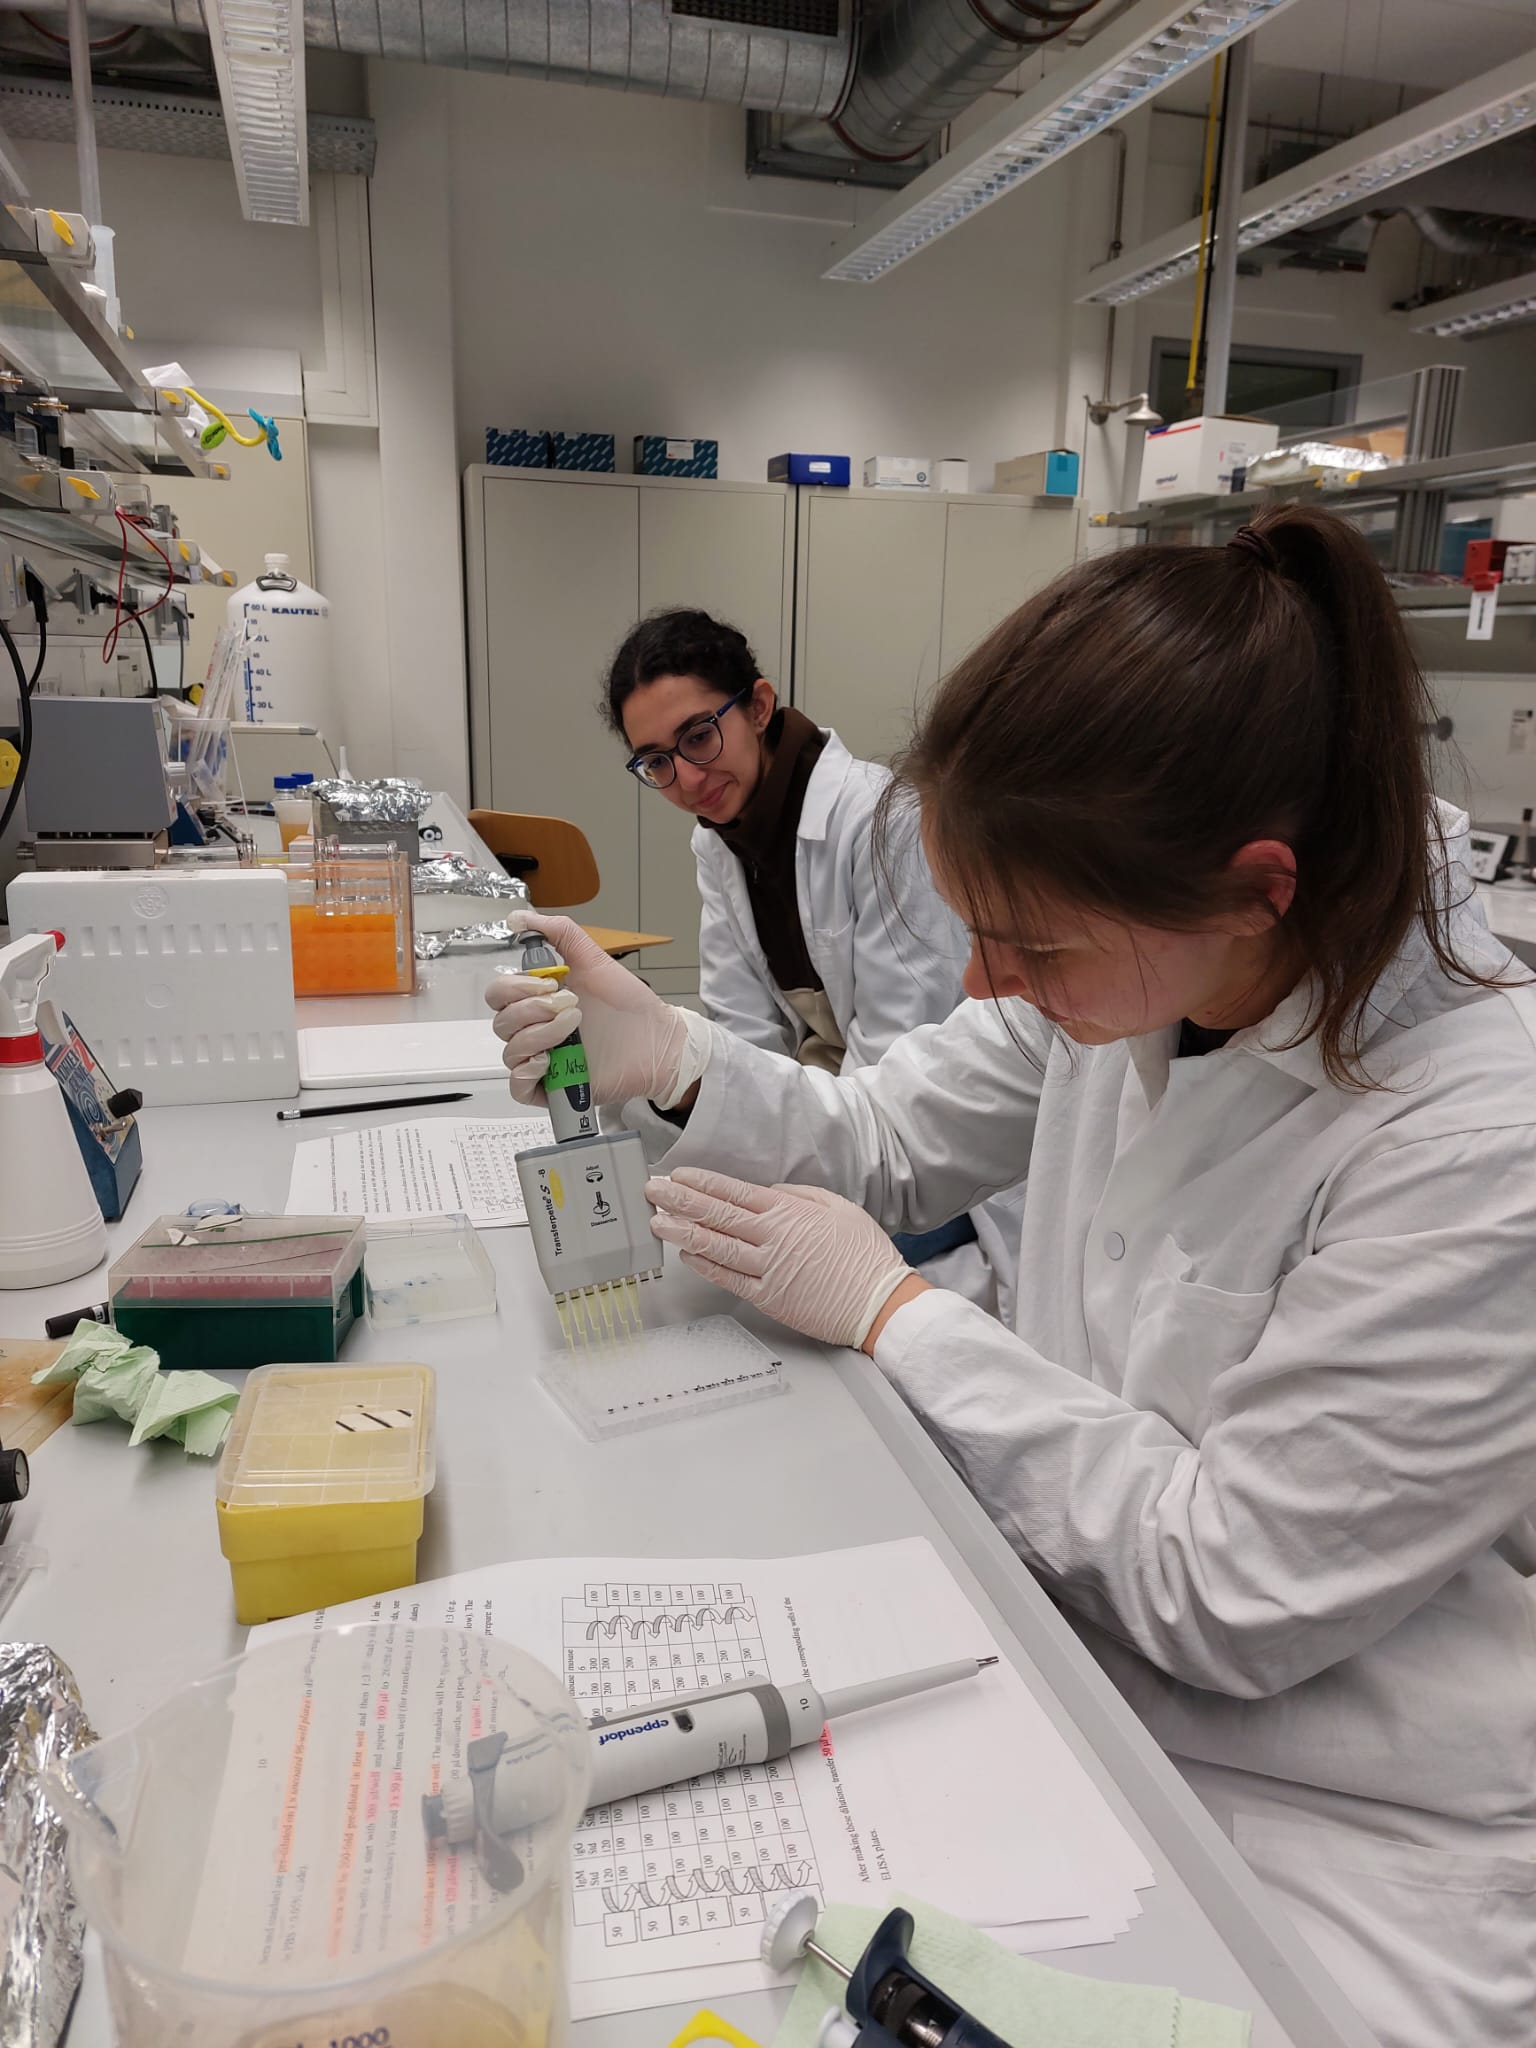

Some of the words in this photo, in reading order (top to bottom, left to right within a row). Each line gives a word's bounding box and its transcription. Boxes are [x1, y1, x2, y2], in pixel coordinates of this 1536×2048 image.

[591, 1591, 599, 1602] 100
[610, 1590, 619, 1601] 100
[633, 1591, 641, 1601] 100
[654, 1591, 662, 1601] 100
[675, 1590, 683, 1601] 100
[696, 1590, 705, 1601] 100
[724, 1589, 733, 1600] 100
[783, 1597, 792, 1605] the
[463, 1600, 473, 1611] The
[483, 1600, 492, 1610] the
[445, 1614, 454, 1624] 1:3
[483, 1611, 493, 1636] prepare
[786, 1612, 798, 1627] wells
[743, 1648, 752, 1660] 200
[791, 1627, 808, 1668] corresponding
[566, 1649, 575, 1671] mouse
[649, 1656, 658, 1667] 200
[672, 1654, 682, 1665] 200
[696, 1652, 705, 1664] 200
[719, 1650, 729, 1662] 200
[589, 1658, 598, 1670] 300
[601, 1658, 610, 1670] 200
[625, 1657, 634, 1669] 200
[801, 1668, 811, 1678] the
[627, 1681, 637, 1693] 200
[651, 1679, 661, 1690] 200
[675, 1677, 685, 1688] 200
[699, 1675, 709, 1687] 200
[590, 1683, 600, 1695] 300
[603, 1682, 612, 1695] 200
[359, 1692, 369, 1709] then
[435, 1691, 445, 1705] will
[358, 1713, 367, 1727] and
[396, 1714, 407, 1730] well
[433, 1708, 443, 1743] standards
[372, 1754, 382, 1768] and
[377, 1706, 387, 1720] 100
[598, 1719, 670, 1746] eppendorf
[395, 1732, 405, 1750] each
[432, 1745, 441, 1759] The
[821, 1747, 832, 1757] 50
[742, 1769, 754, 1782] 200
[768, 1766, 779, 1779] 200
[824, 1758, 841, 1783] transfer
[716, 1771, 727, 1785] 200
[721, 1798, 732, 1811] 100
[748, 1795, 759, 1808] 100
[774, 1792, 786, 1805] 100
[834, 1783, 850, 1815] dilutions,
[640, 1806, 651, 1819] 100
[668, 1803, 678, 1816] 100
[695, 1801, 705, 1814] 100
[585, 1813, 596, 1827] Std
[599, 1811, 610, 1824] 120
[613, 1809, 623, 1822] 100
[755, 1821, 766, 1835] 100
[780, 1818, 791, 1831] 100
[843, 1815, 856, 1832] these
[671, 1832, 681, 1844] 100
[699, 1828, 710, 1842] 100
[727, 1825, 737, 1838] 100
[601, 1840, 611, 1853] 120
[616, 1837, 626, 1851] 100
[644, 1834, 654, 1847] 100
[588, 1843, 598, 1855] Std
[786, 1844, 799, 1859] 100
[849, 1833, 865, 1862] making
[702, 1855, 714, 1869] 100
[730, 1851, 743, 1866] 100
[759, 1849, 771, 1863] 100
[646, 1862, 657, 1878] 100
[675, 1858, 686, 1873] 100
[875, 1854, 891, 1881] ELISA
[575, 1870, 588, 1888] IgM
[589, 1872, 600, 1886] Std
[604, 1868, 614, 1884] 120
[618, 1866, 629, 1882] 100
[858, 1863, 871, 1884] After
[706, 1911, 718, 1922] 50
[739, 1907, 751, 1918] 50
[648, 1921, 659, 1933] 50
[679, 1915, 690, 1927] 50
[612, 1926, 623, 1939] 50
